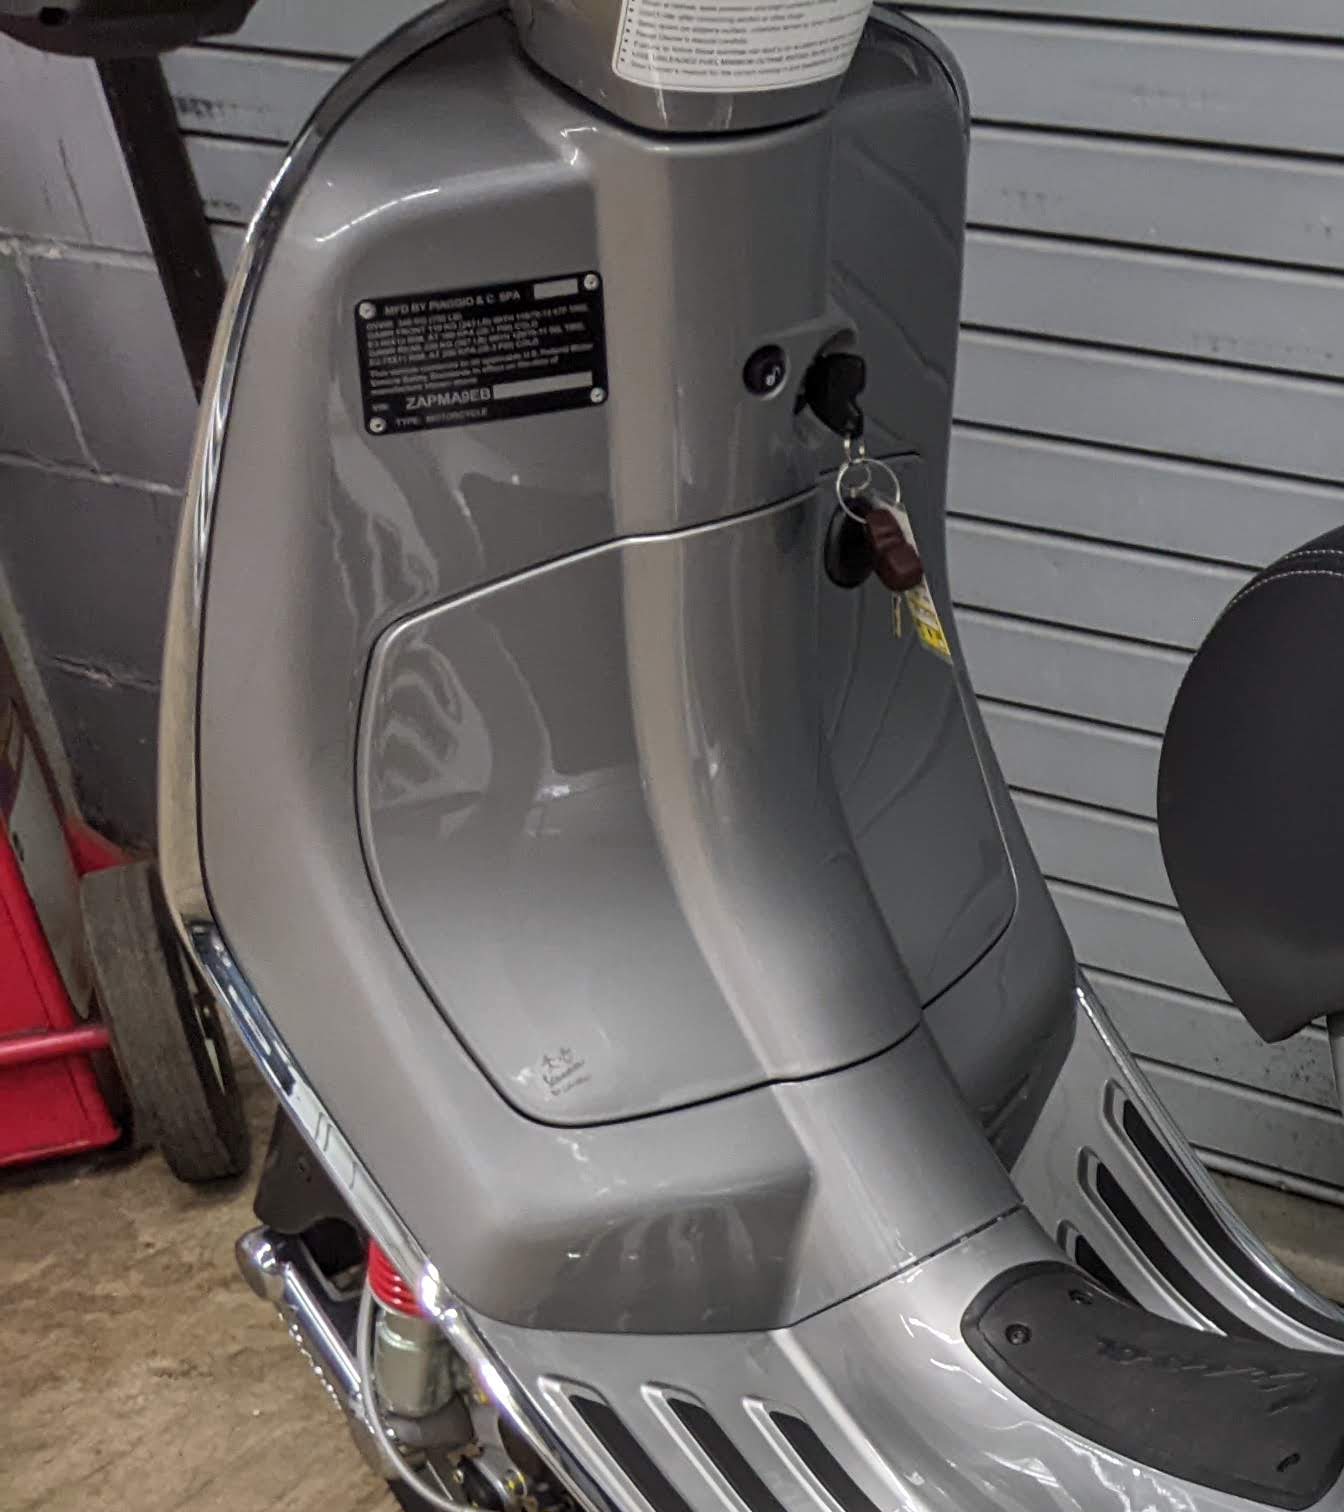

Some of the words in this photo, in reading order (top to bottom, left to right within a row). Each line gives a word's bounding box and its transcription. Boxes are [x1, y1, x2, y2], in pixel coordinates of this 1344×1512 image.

[384, 303, 409, 316] MFD
[411, 300, 427, 313] BY
[429, 296, 474, 311] PIAGGIO
[499, 290, 521, 302] SPA
